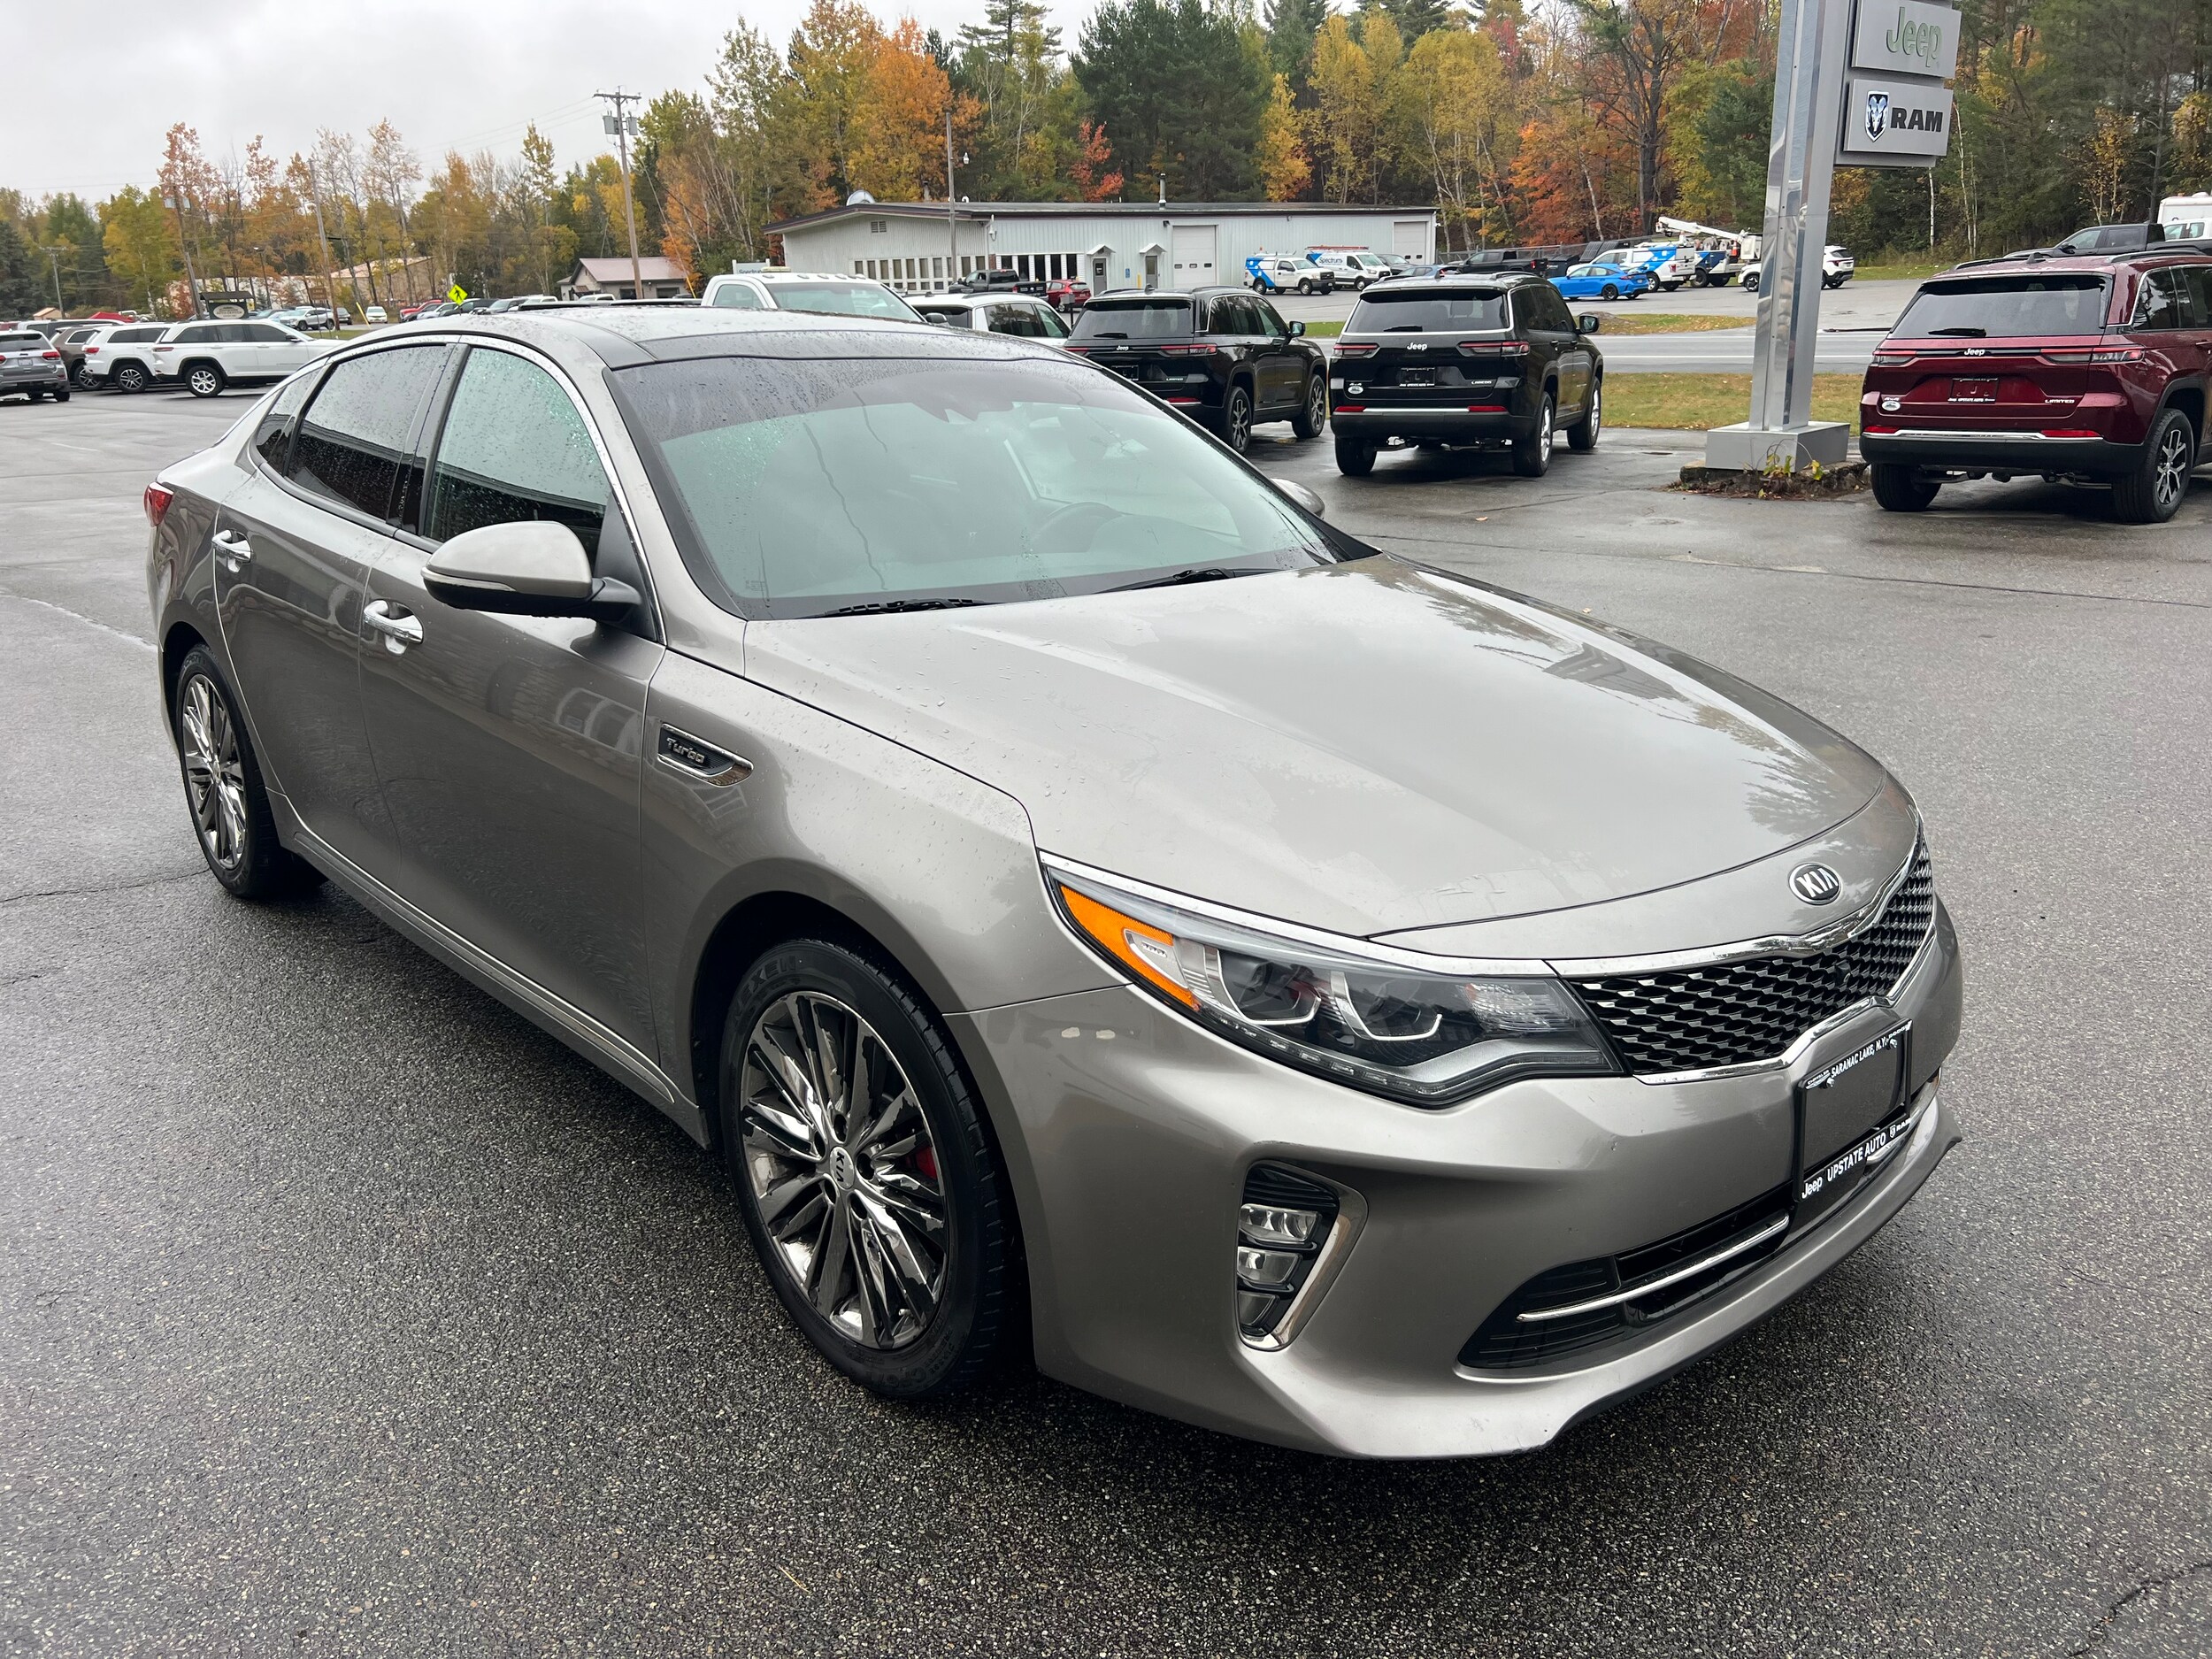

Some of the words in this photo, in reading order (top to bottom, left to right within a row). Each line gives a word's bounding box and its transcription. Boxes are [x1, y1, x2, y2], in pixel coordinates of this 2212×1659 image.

[1886, 6, 1943, 67] Jeep
[1890, 107, 1943, 133] RAM
[1407, 342, 1428, 351] Jeep
[1964, 348, 1985, 357] Jeep
[666, 737, 705, 764] Turbo
[1795, 867, 1839, 898] KIA
[1830, 1052, 1859, 1079] SARANAC
[836, 1151, 845, 1183] KIA
[1801, 1176, 1823, 1199] Jeep
[1826, 1146, 1863, 1182] UPSTATE
[1864, 1132, 1886, 1157] AUTO
